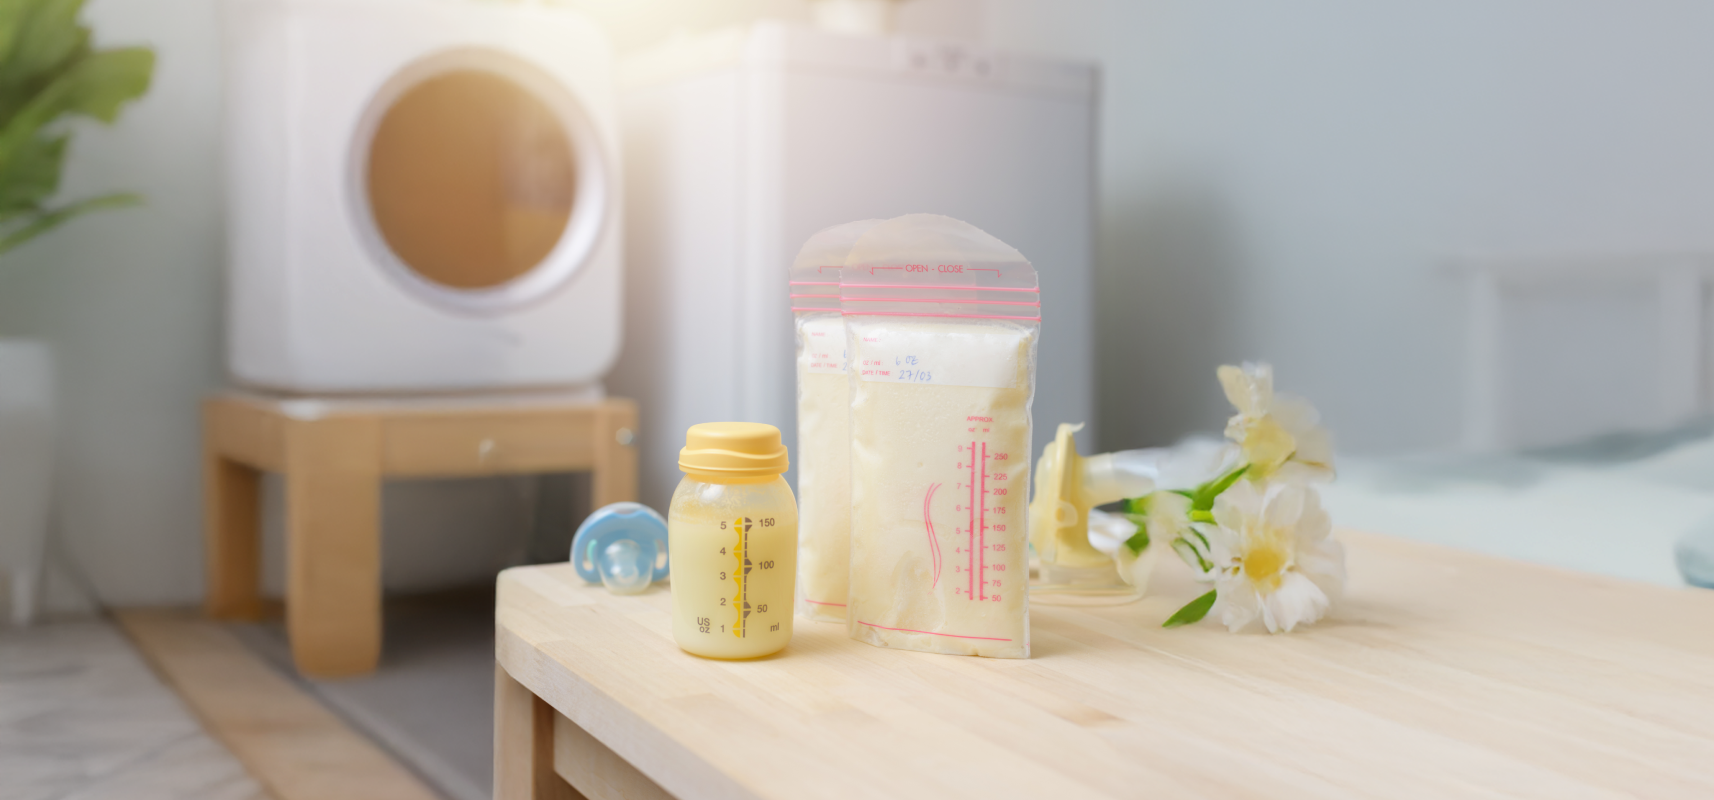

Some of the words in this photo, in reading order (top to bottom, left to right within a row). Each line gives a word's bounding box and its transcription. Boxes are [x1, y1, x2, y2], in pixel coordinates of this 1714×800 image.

[905, 264, 928, 272] OPEN
[938, 265, 964, 273] CLOSE
[898, 369, 932, 382] 27/03
[994, 452, 1008, 460] 250
[957, 462, 962, 470] 8
[994, 472, 1008, 480] 225
[993, 506, 1006, 514] 175
[720, 520, 727, 530] 5
[758, 518, 776, 528] 150
[720, 546, 726, 556] 4
[758, 560, 774, 570] 100
[992, 564, 1006, 572] 100
[720, 572, 726, 580] 3
[720, 597, 726, 606] 2
[757, 604, 768, 613] 50
[697, 616, 710, 626] US
[720, 624, 724, 632] 1
[770, 622, 780, 632] ml
